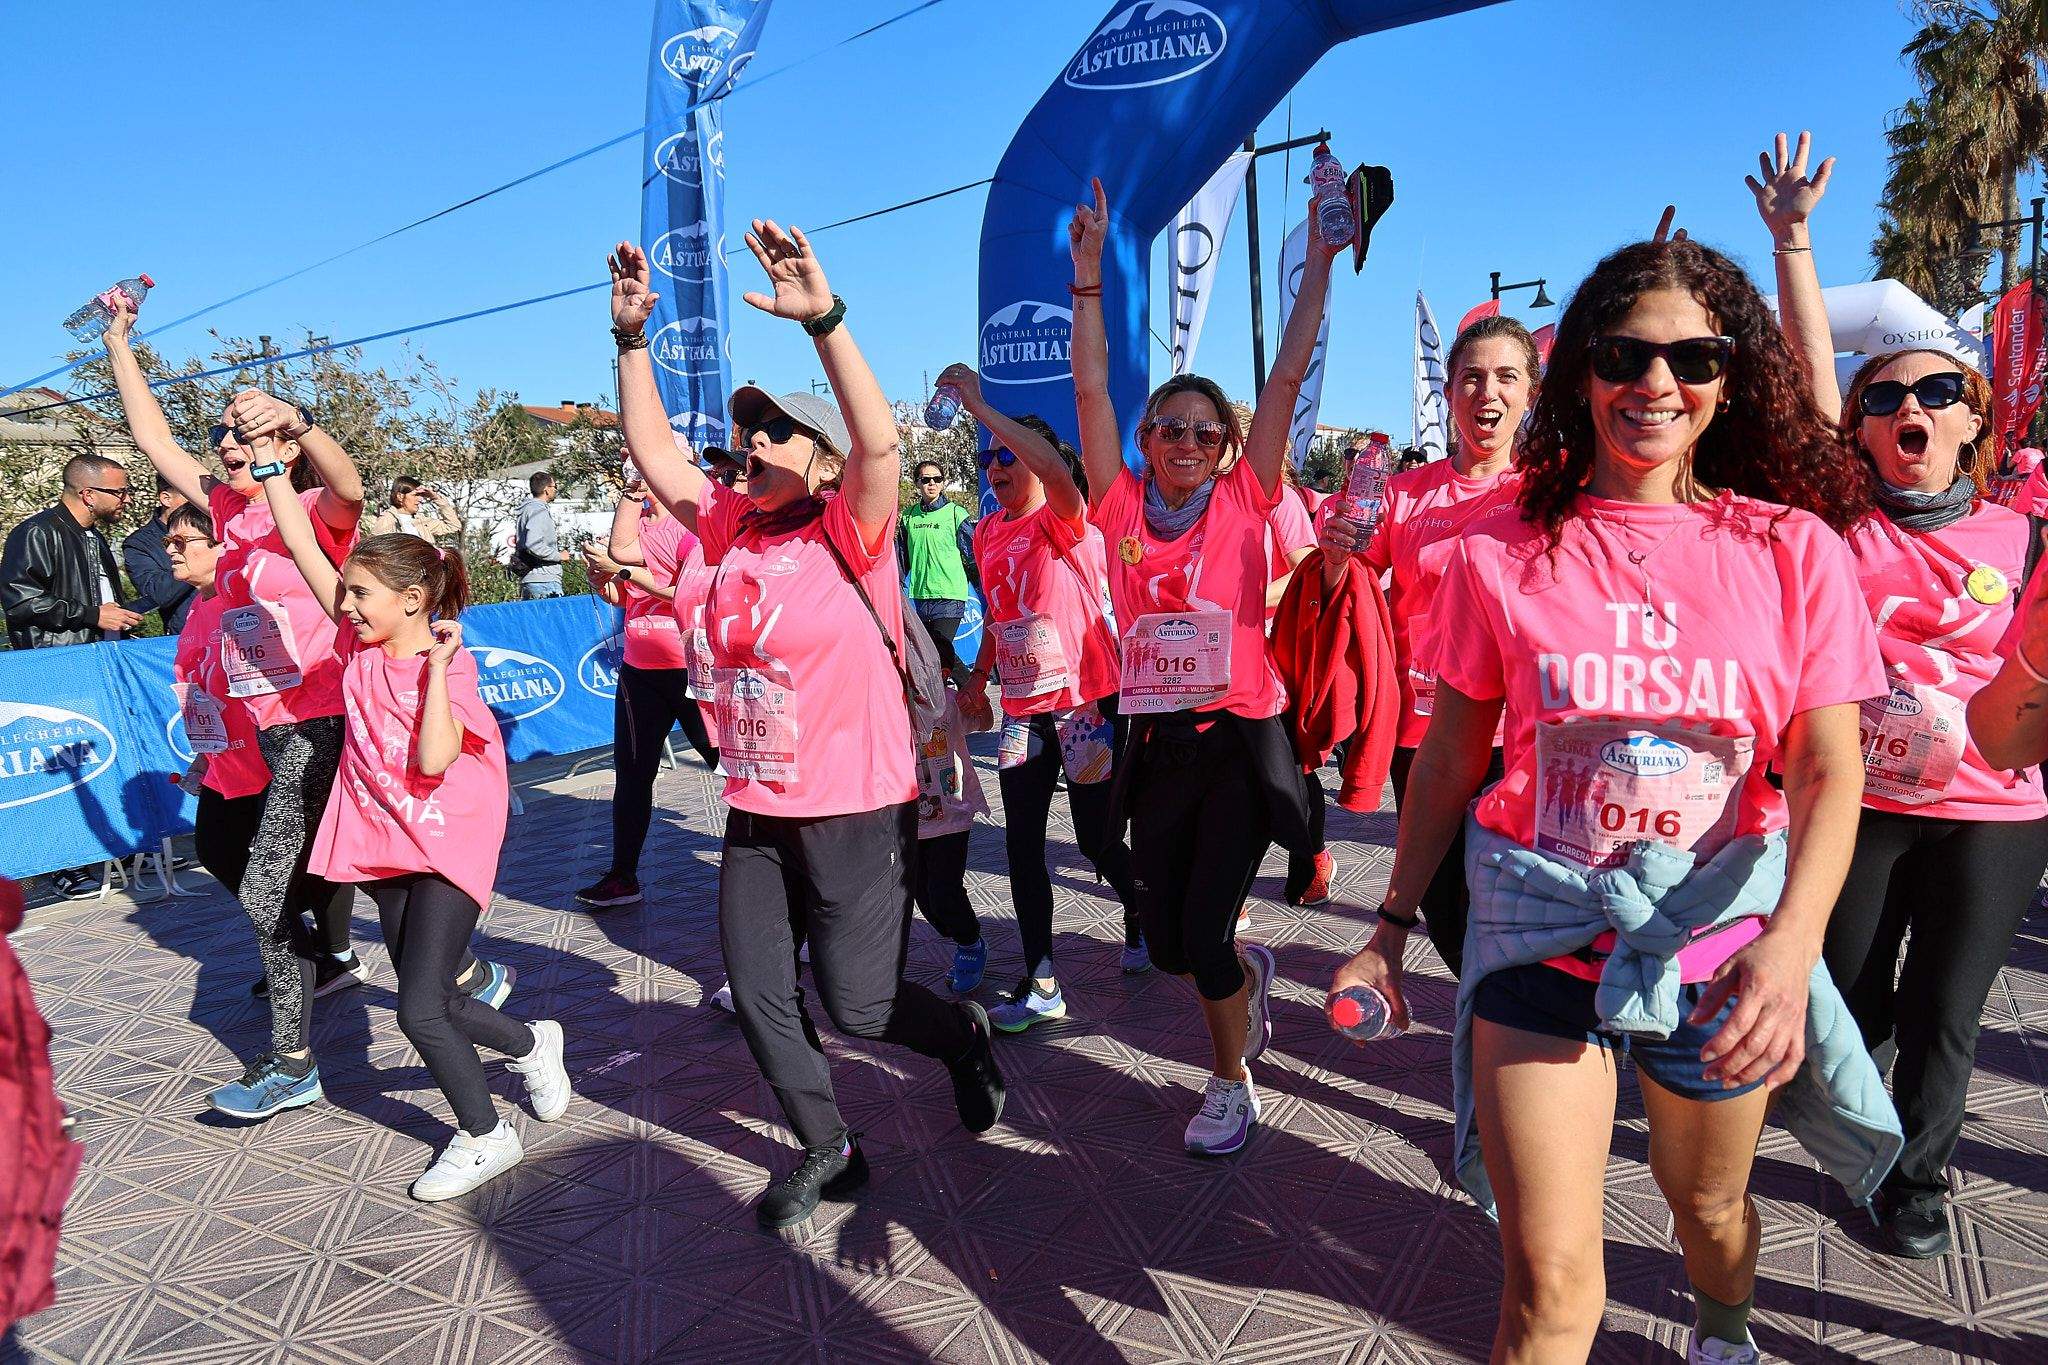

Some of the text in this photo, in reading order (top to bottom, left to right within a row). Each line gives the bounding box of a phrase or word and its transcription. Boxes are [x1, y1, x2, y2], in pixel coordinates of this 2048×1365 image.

[1096, 18, 1207, 49] CENTRAL LECHERA
[1071, 31, 1214, 80] ASTURIANA
[990, 328, 1032, 341] CENTRAL
[1882, 327, 1944, 347] OYSHO
[2007, 308, 2025, 387] Santander
[1605, 601, 1678, 650] TU
[239, 645, 266, 662] 016
[1010, 652, 1037, 668] 016
[493, 667, 545, 680] LECHERA
[1155, 657, 1197, 673] 016
[1162, 677, 1182, 685] 3282
[1538, 652, 1745, 720] DORSAL
[1130, 694, 1164, 708] OYSHO
[1, 726, 85, 746] LECHERA
[737, 718, 767, 738] 016
[1603, 747, 1682, 768] ASTURIANA
[1876, 784, 1926, 800] Santander
[1600, 803, 1682, 838] 016
[1555, 843, 1591, 863] CARRERA
